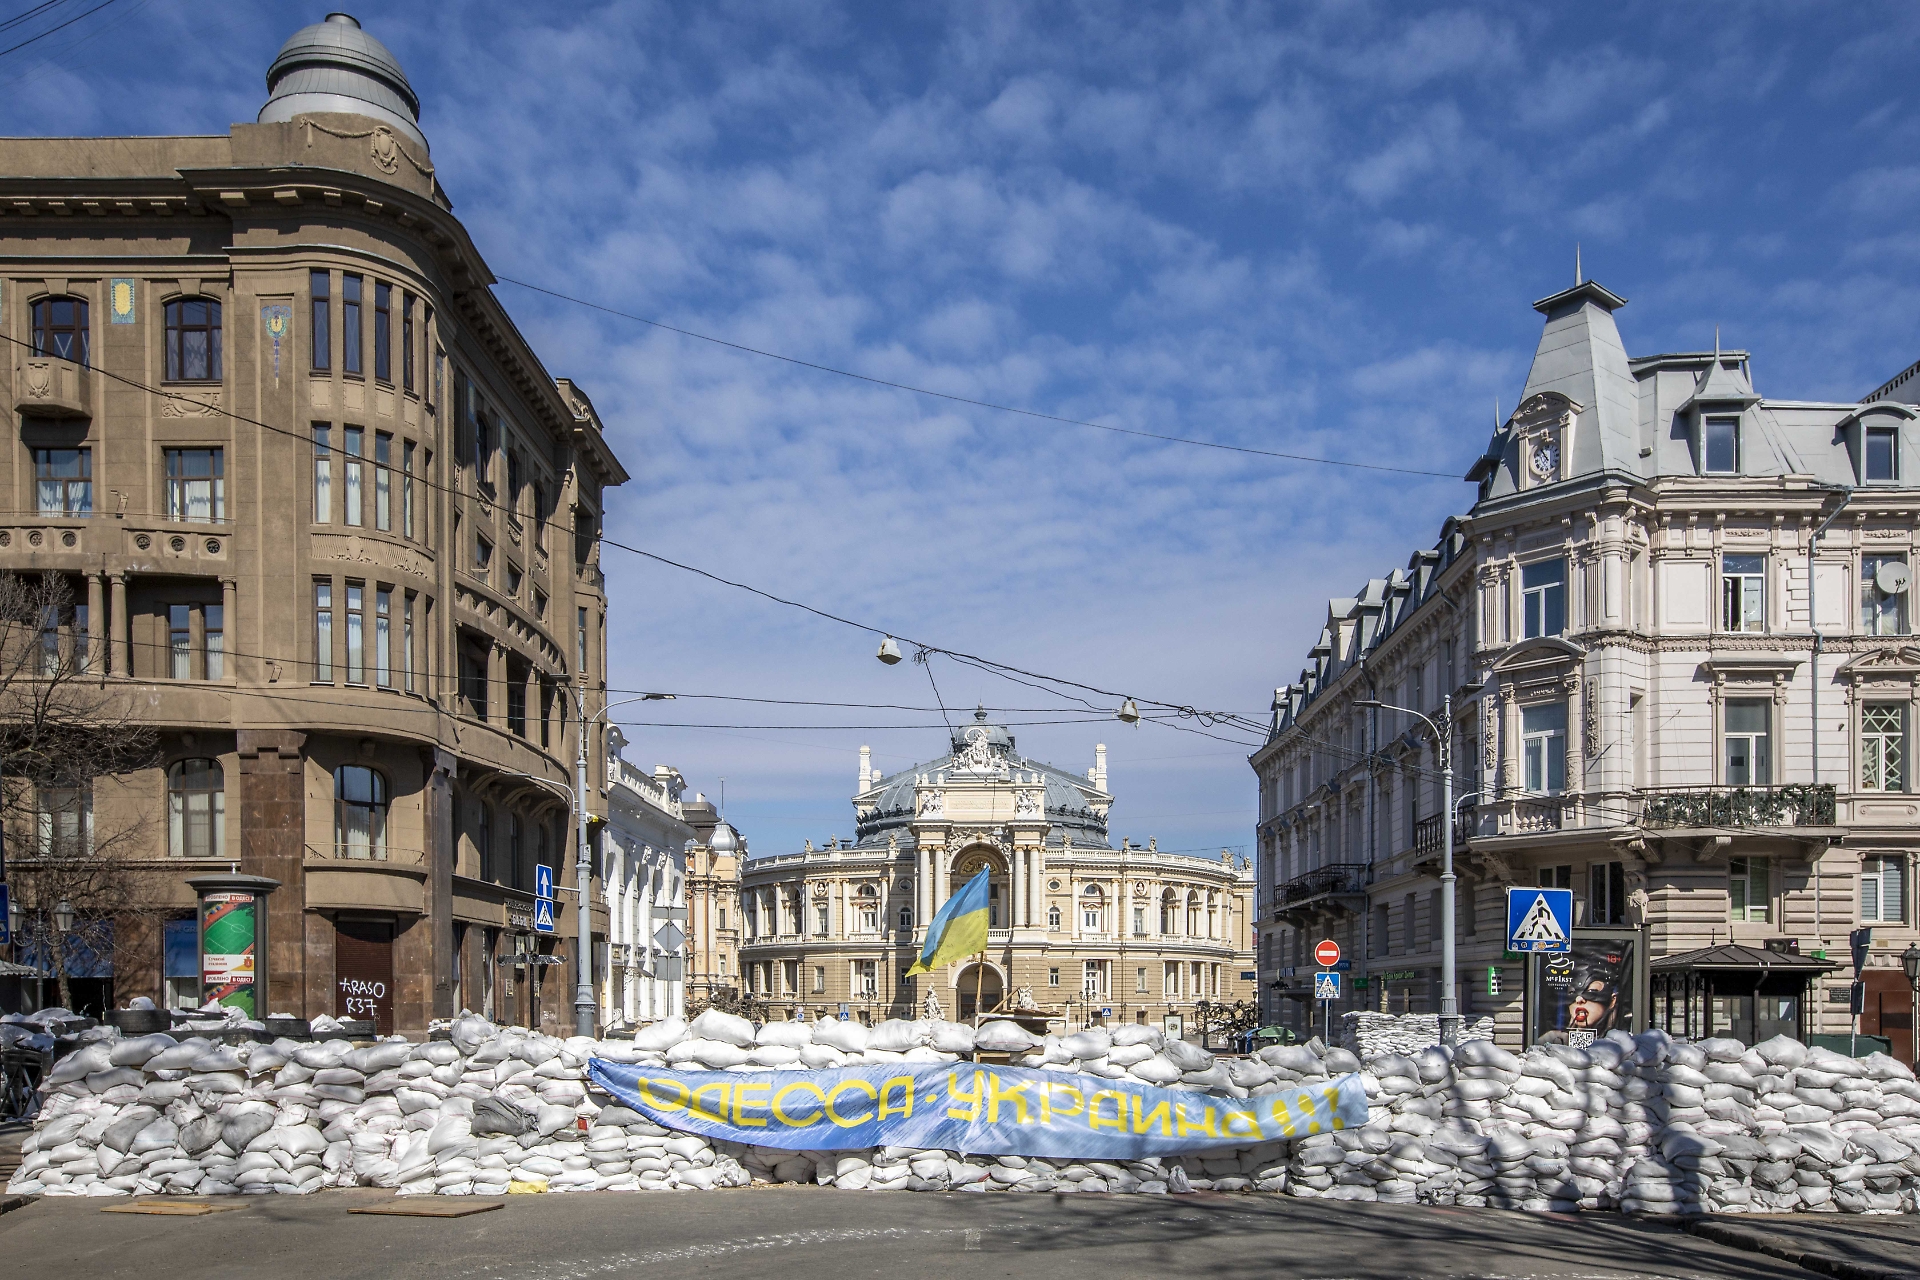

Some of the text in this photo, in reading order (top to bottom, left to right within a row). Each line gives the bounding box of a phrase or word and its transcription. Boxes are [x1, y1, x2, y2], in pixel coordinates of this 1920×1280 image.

[1607, 954, 1621, 963] 18+
[346, 997, 377, 1016] R37
[638, 1075, 915, 1128] ОДЕССА
